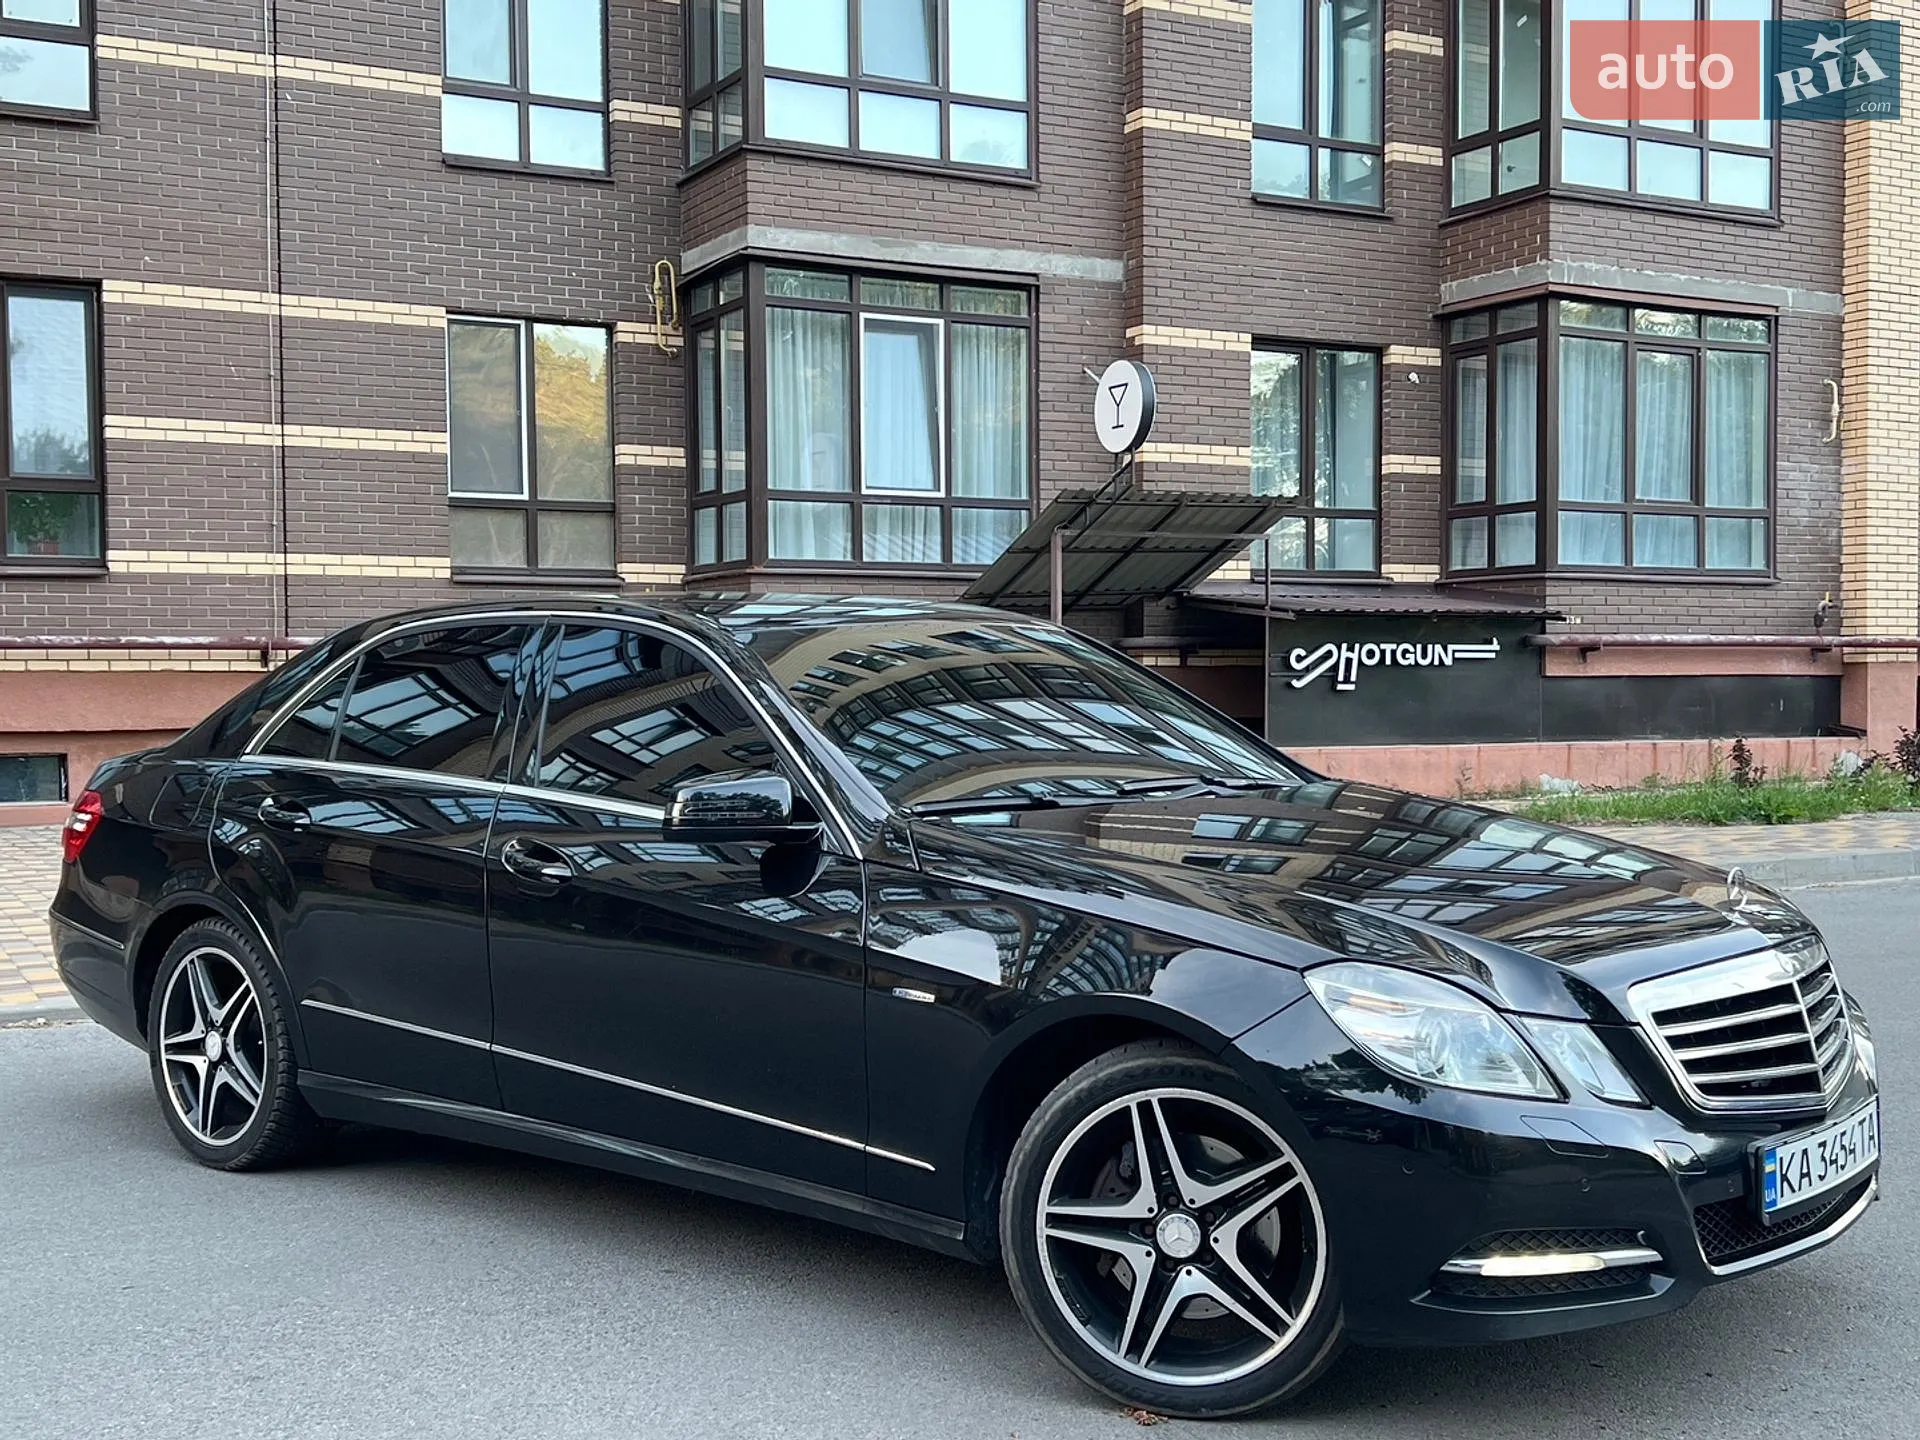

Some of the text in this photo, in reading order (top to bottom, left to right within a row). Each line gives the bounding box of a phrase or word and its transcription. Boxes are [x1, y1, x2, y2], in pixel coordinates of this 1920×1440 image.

[1289, 642, 1453, 690] SHOTGUN
[1780, 1112, 1876, 1198] KA 3454 TA
